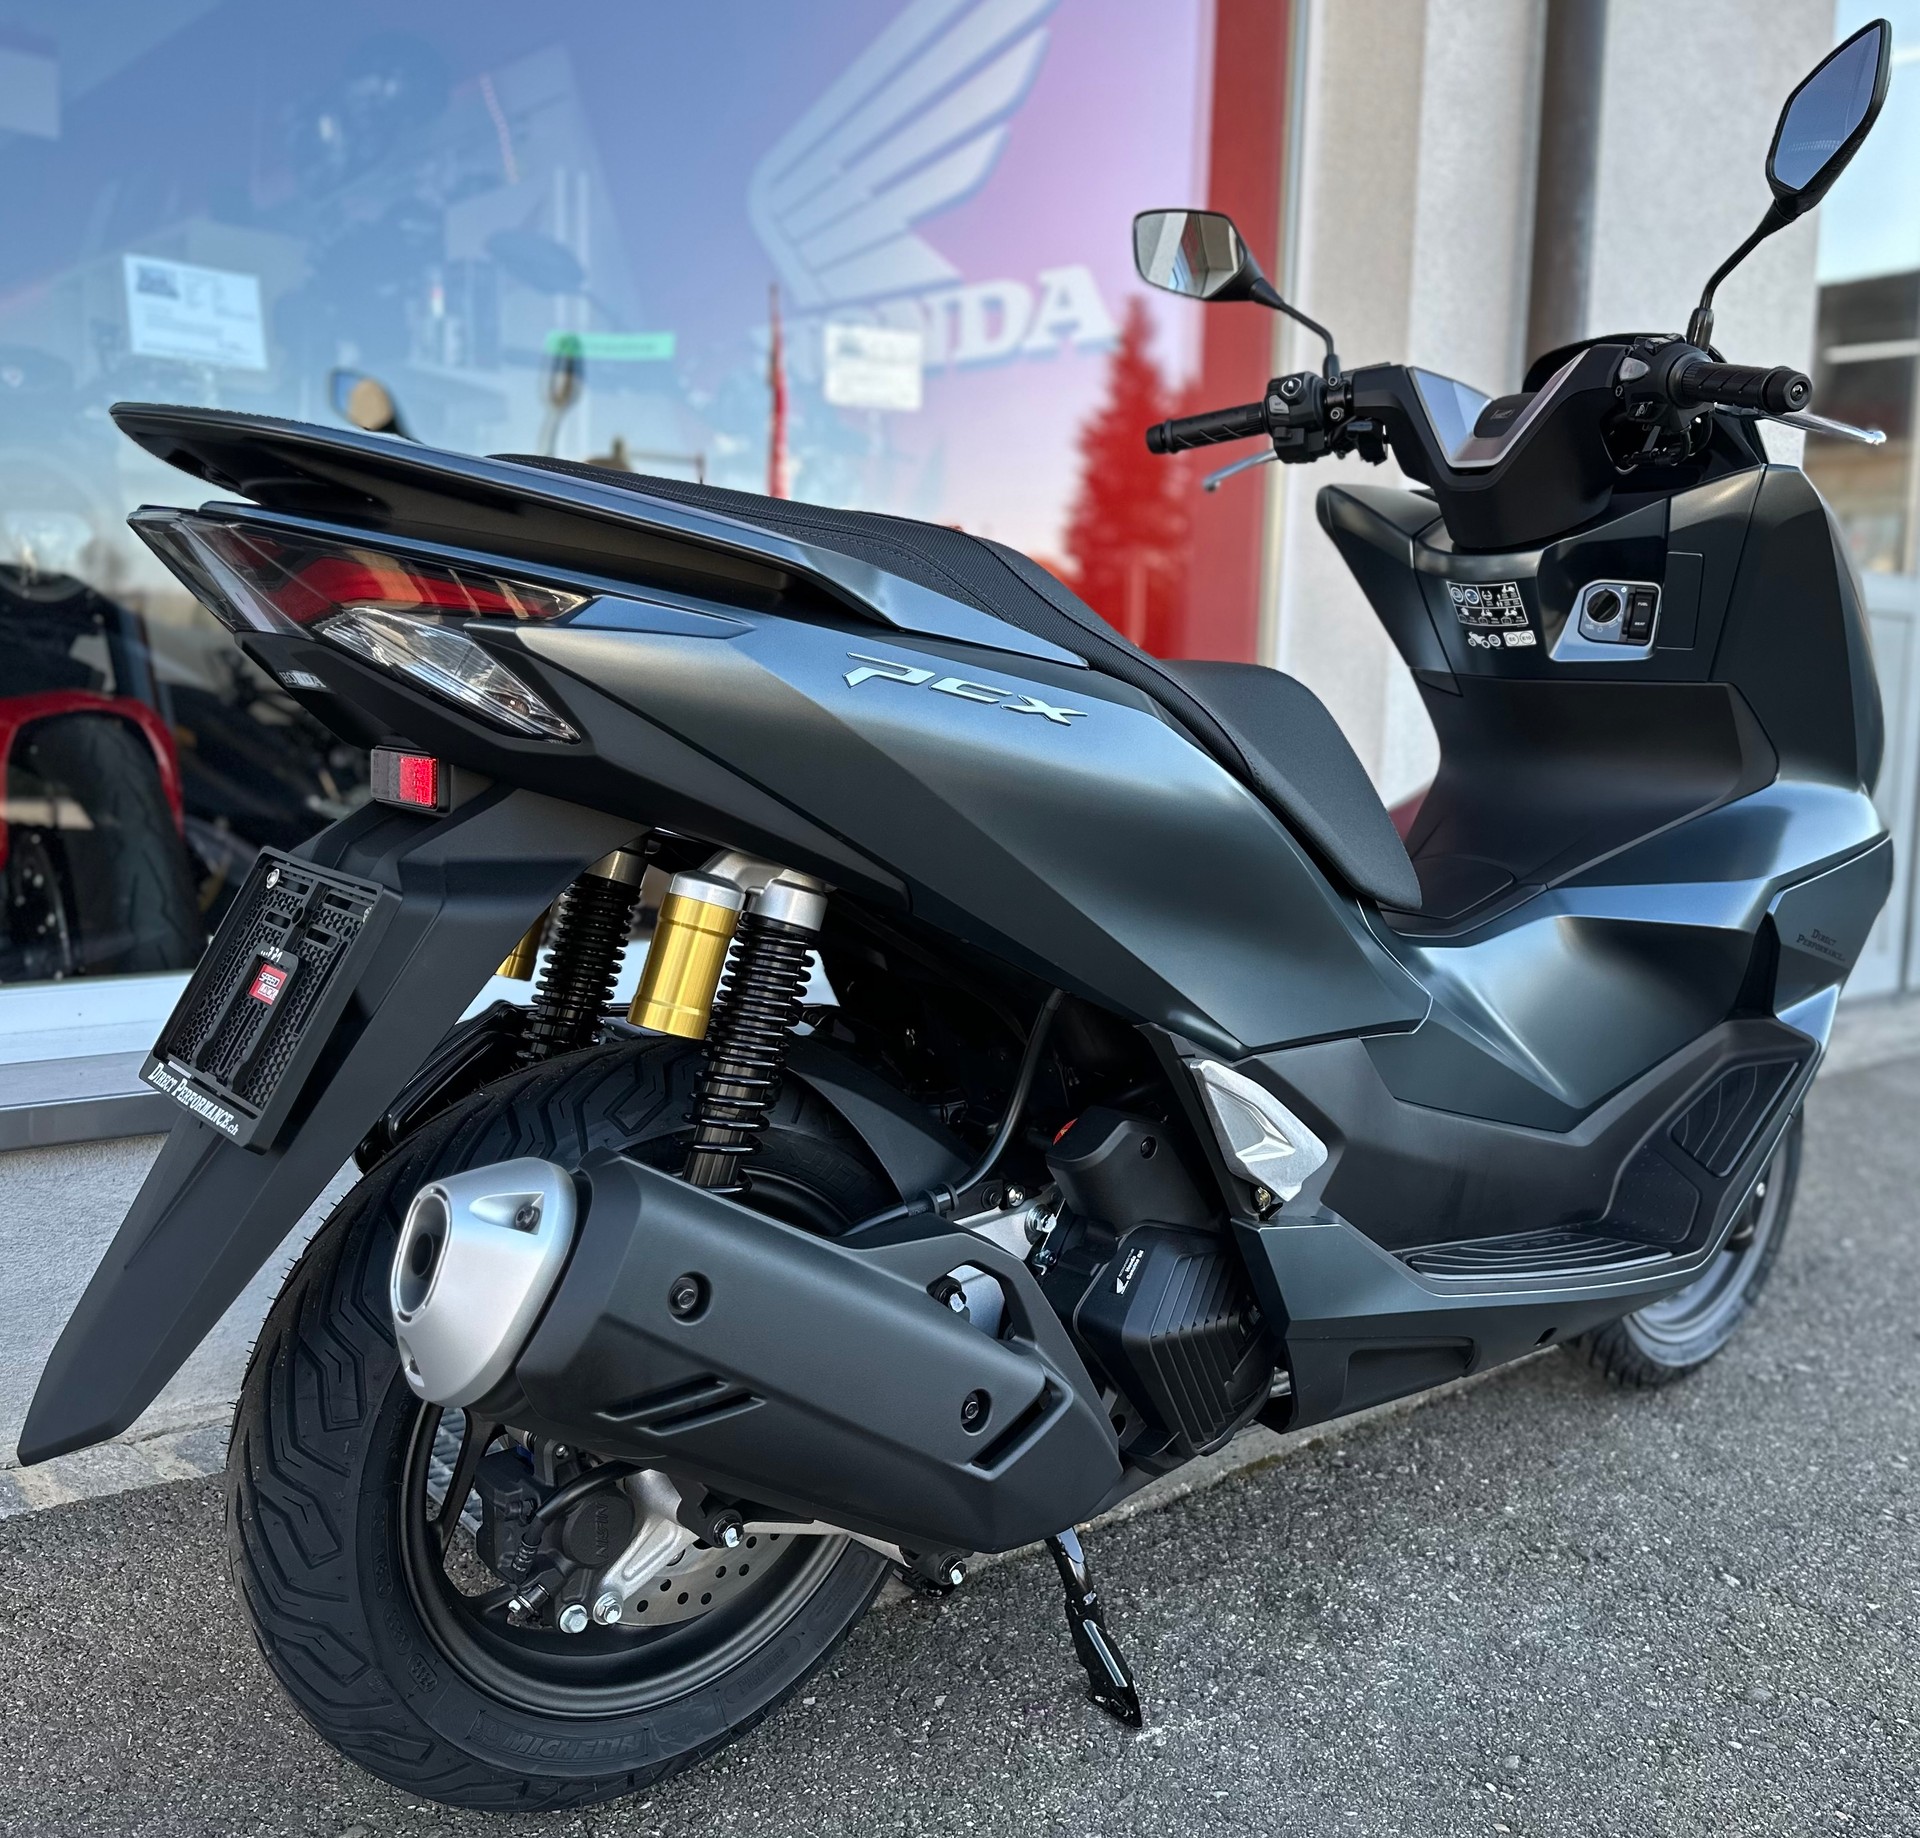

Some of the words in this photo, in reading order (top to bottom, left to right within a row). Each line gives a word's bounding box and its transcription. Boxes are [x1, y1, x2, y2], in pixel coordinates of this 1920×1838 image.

[279, 670, 327, 688] HONDA
[843, 651, 1088, 727] PCX
[258, 972, 281, 988] SPEED
[147, 1062, 178, 1092] DIRECT
[171, 1078, 239, 1136] PERFORMANCE.ch
[502, 1729, 642, 1759] MICHELIN
